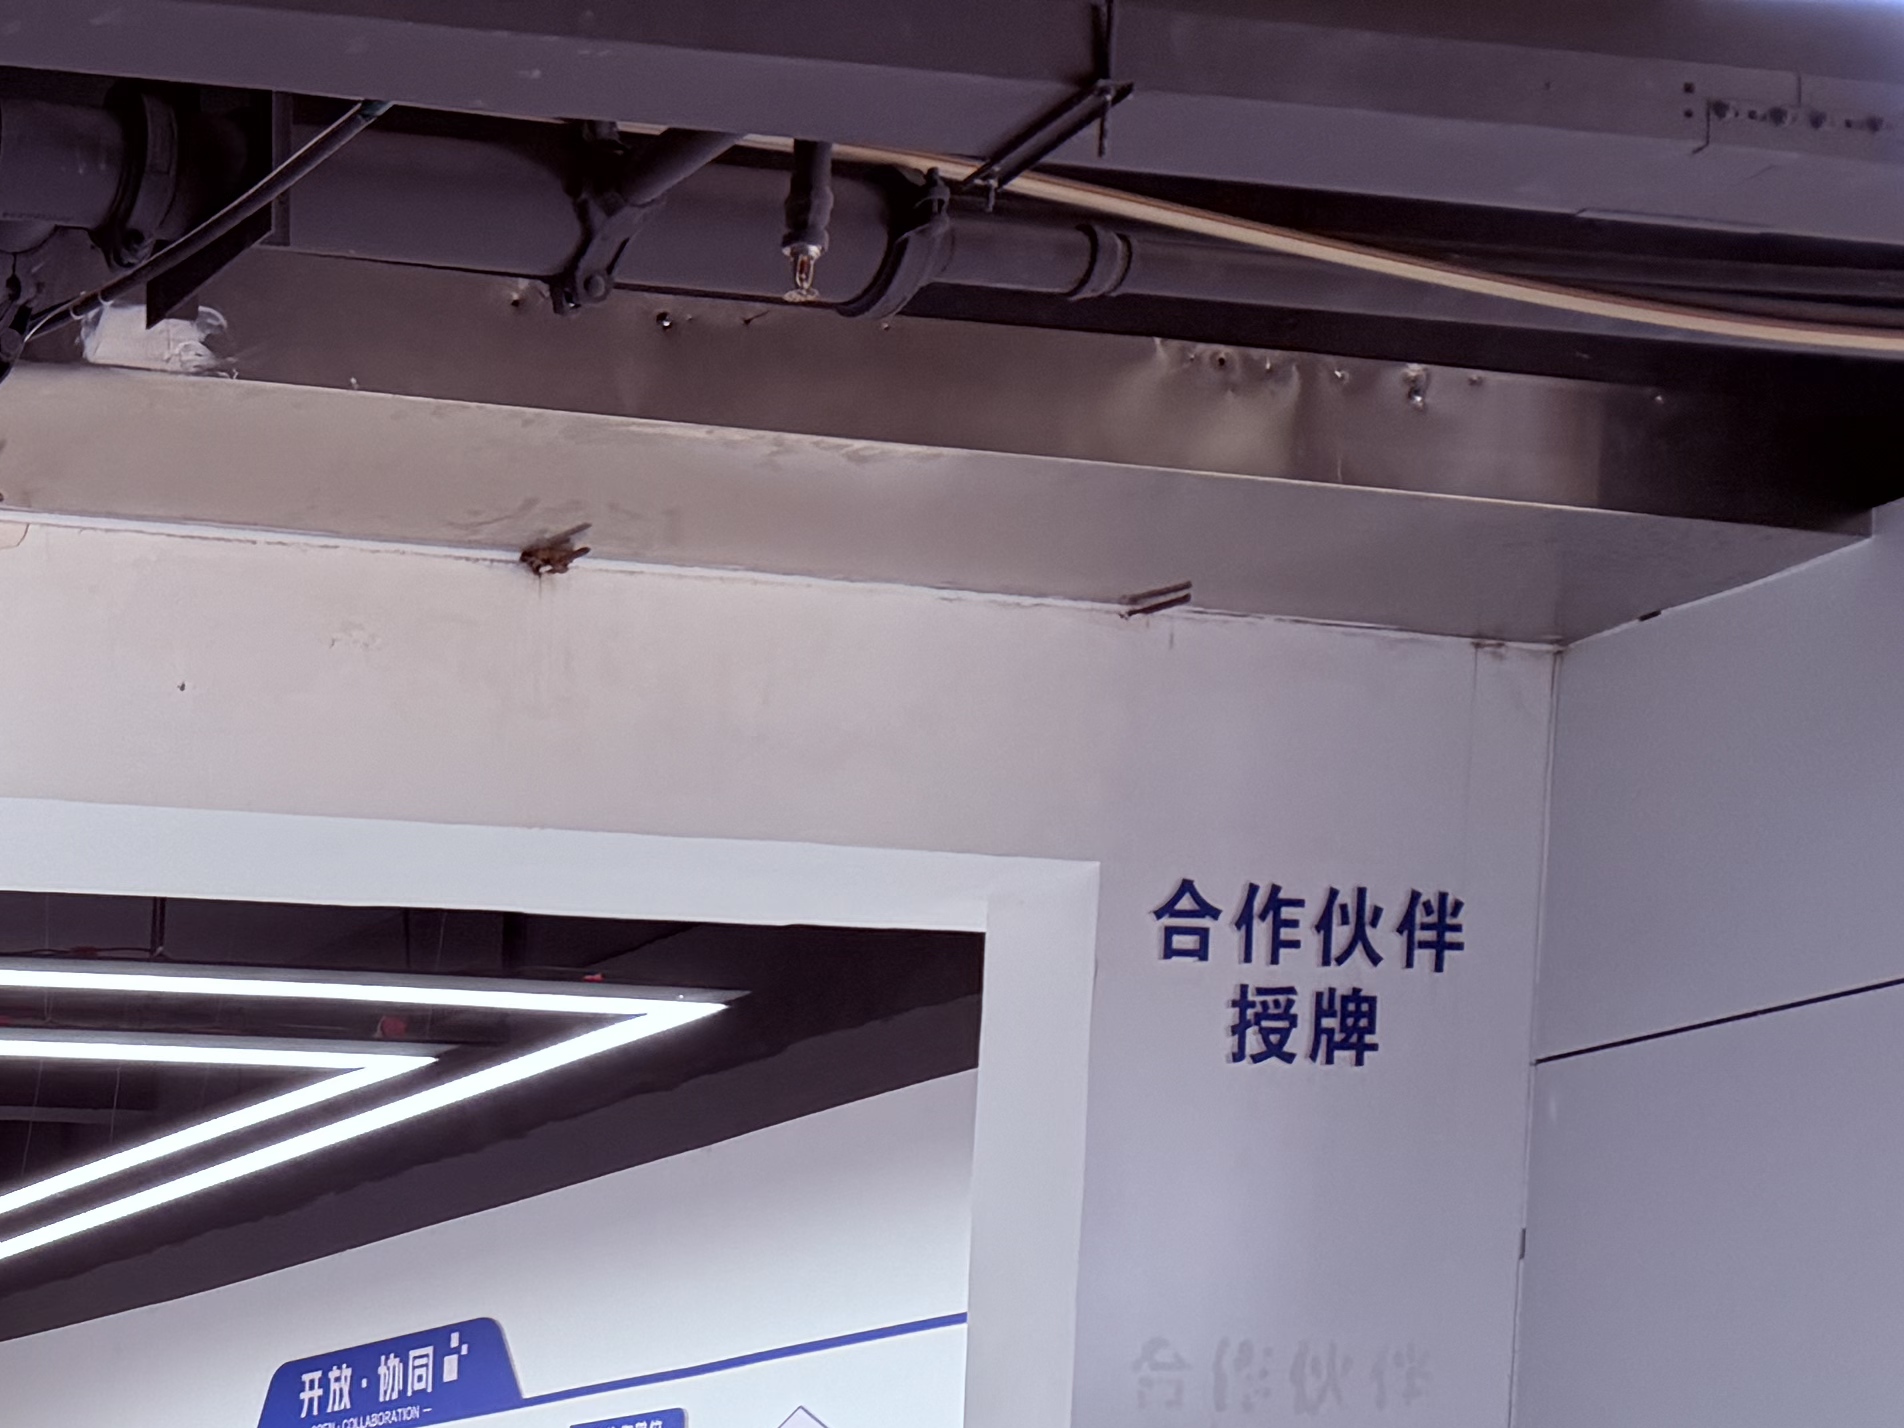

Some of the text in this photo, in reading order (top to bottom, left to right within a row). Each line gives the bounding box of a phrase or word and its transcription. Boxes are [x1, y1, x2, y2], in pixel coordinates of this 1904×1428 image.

[1151, 876, 1466, 974] 合作伙伴
[1228, 983, 1381, 1068] 授牌
